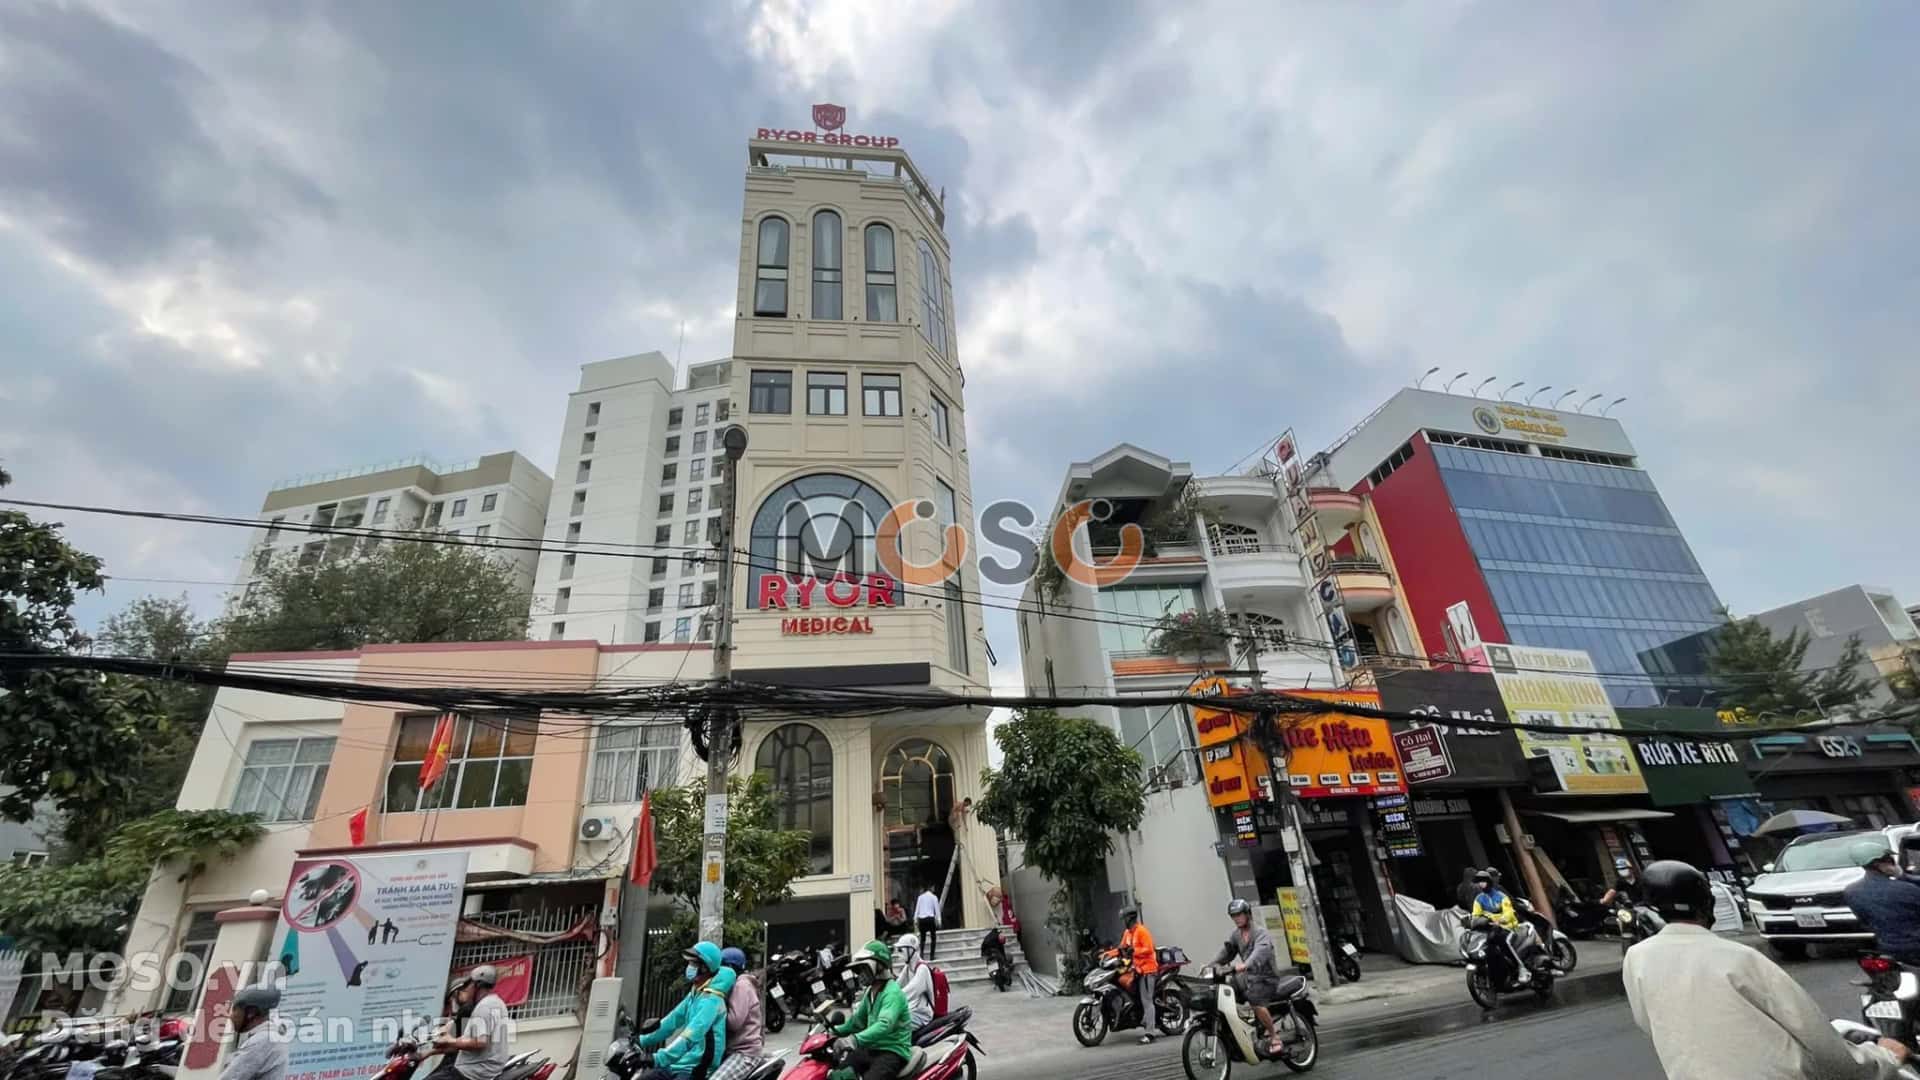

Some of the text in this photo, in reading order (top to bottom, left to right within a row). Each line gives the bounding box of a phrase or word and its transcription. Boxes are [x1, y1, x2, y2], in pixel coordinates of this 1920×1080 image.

[757, 128, 899, 148] RYOR GROUP
[759, 573, 897, 610] RYOR
[781, 616, 874, 635] MEDICAL
[1674, 742, 1702, 764] XE
